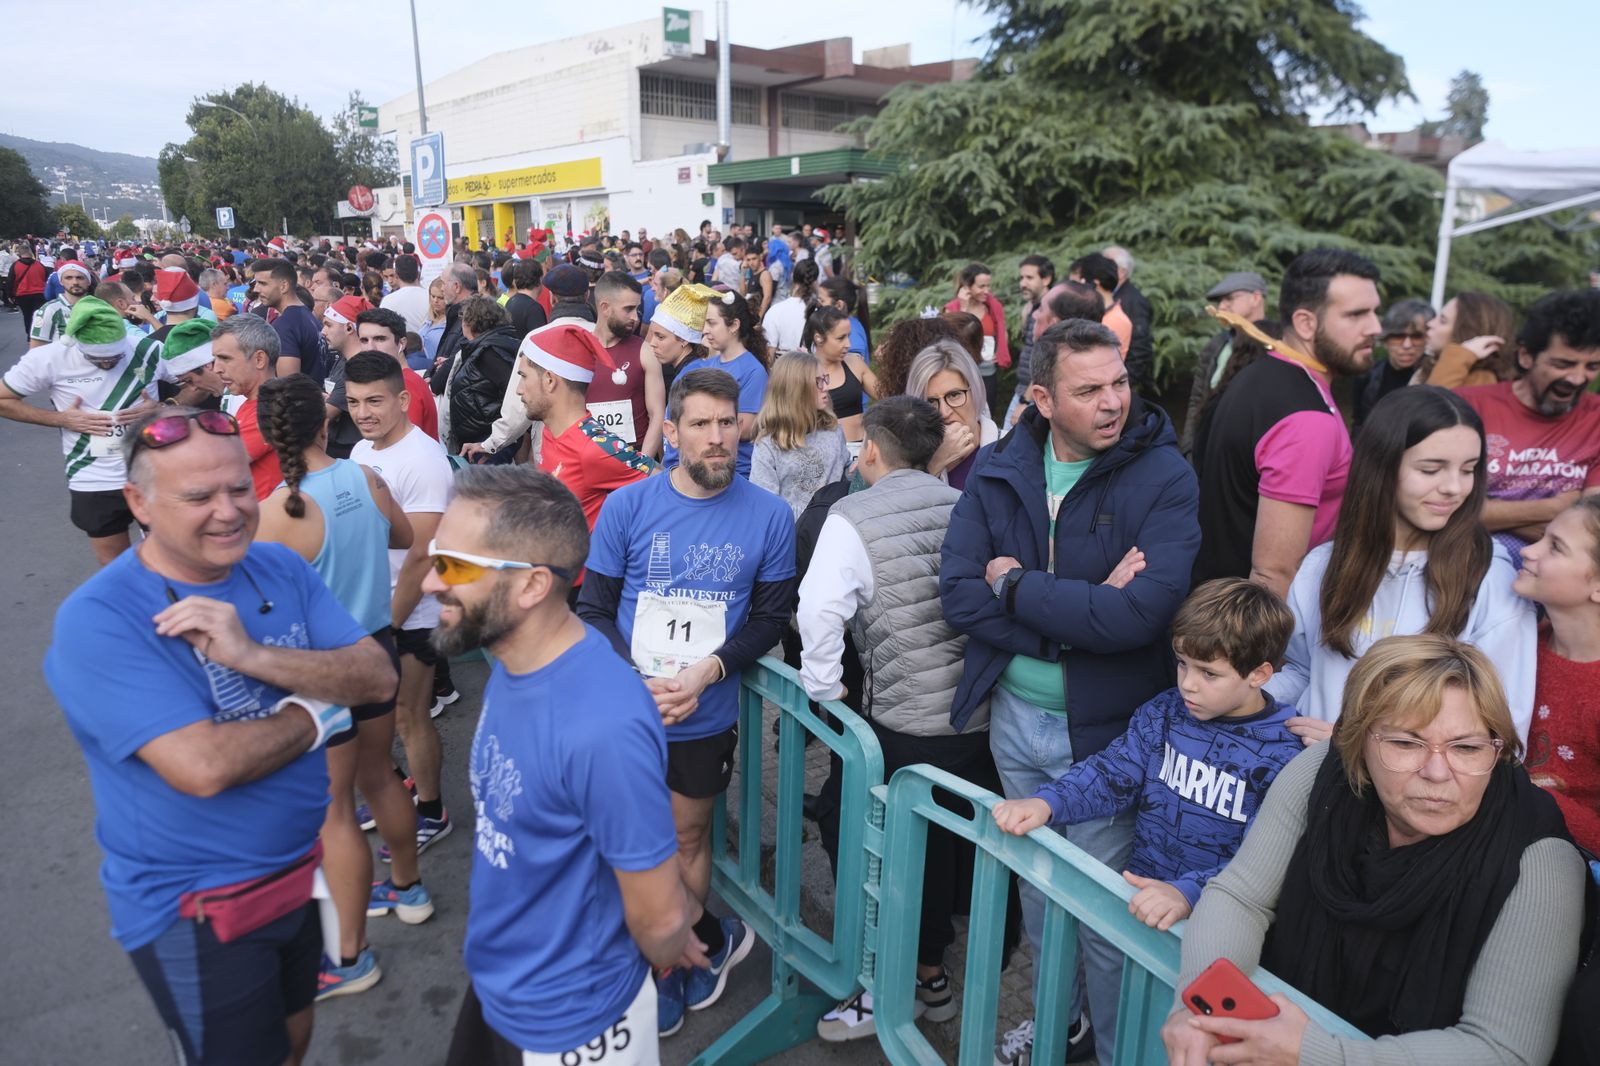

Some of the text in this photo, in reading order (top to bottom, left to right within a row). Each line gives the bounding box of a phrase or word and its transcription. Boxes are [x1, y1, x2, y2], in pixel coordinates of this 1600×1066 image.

[415, 144, 435, 199] P
[498, 168, 556, 192] supermercados
[219, 210, 230, 226] P
[597, 413, 624, 427] 602
[1505, 459, 1588, 479] MARATÓN
[668, 588, 737, 601] SILVESTRE
[666, 619, 692, 642] 11
[1158, 742, 1248, 823] MARVEL
